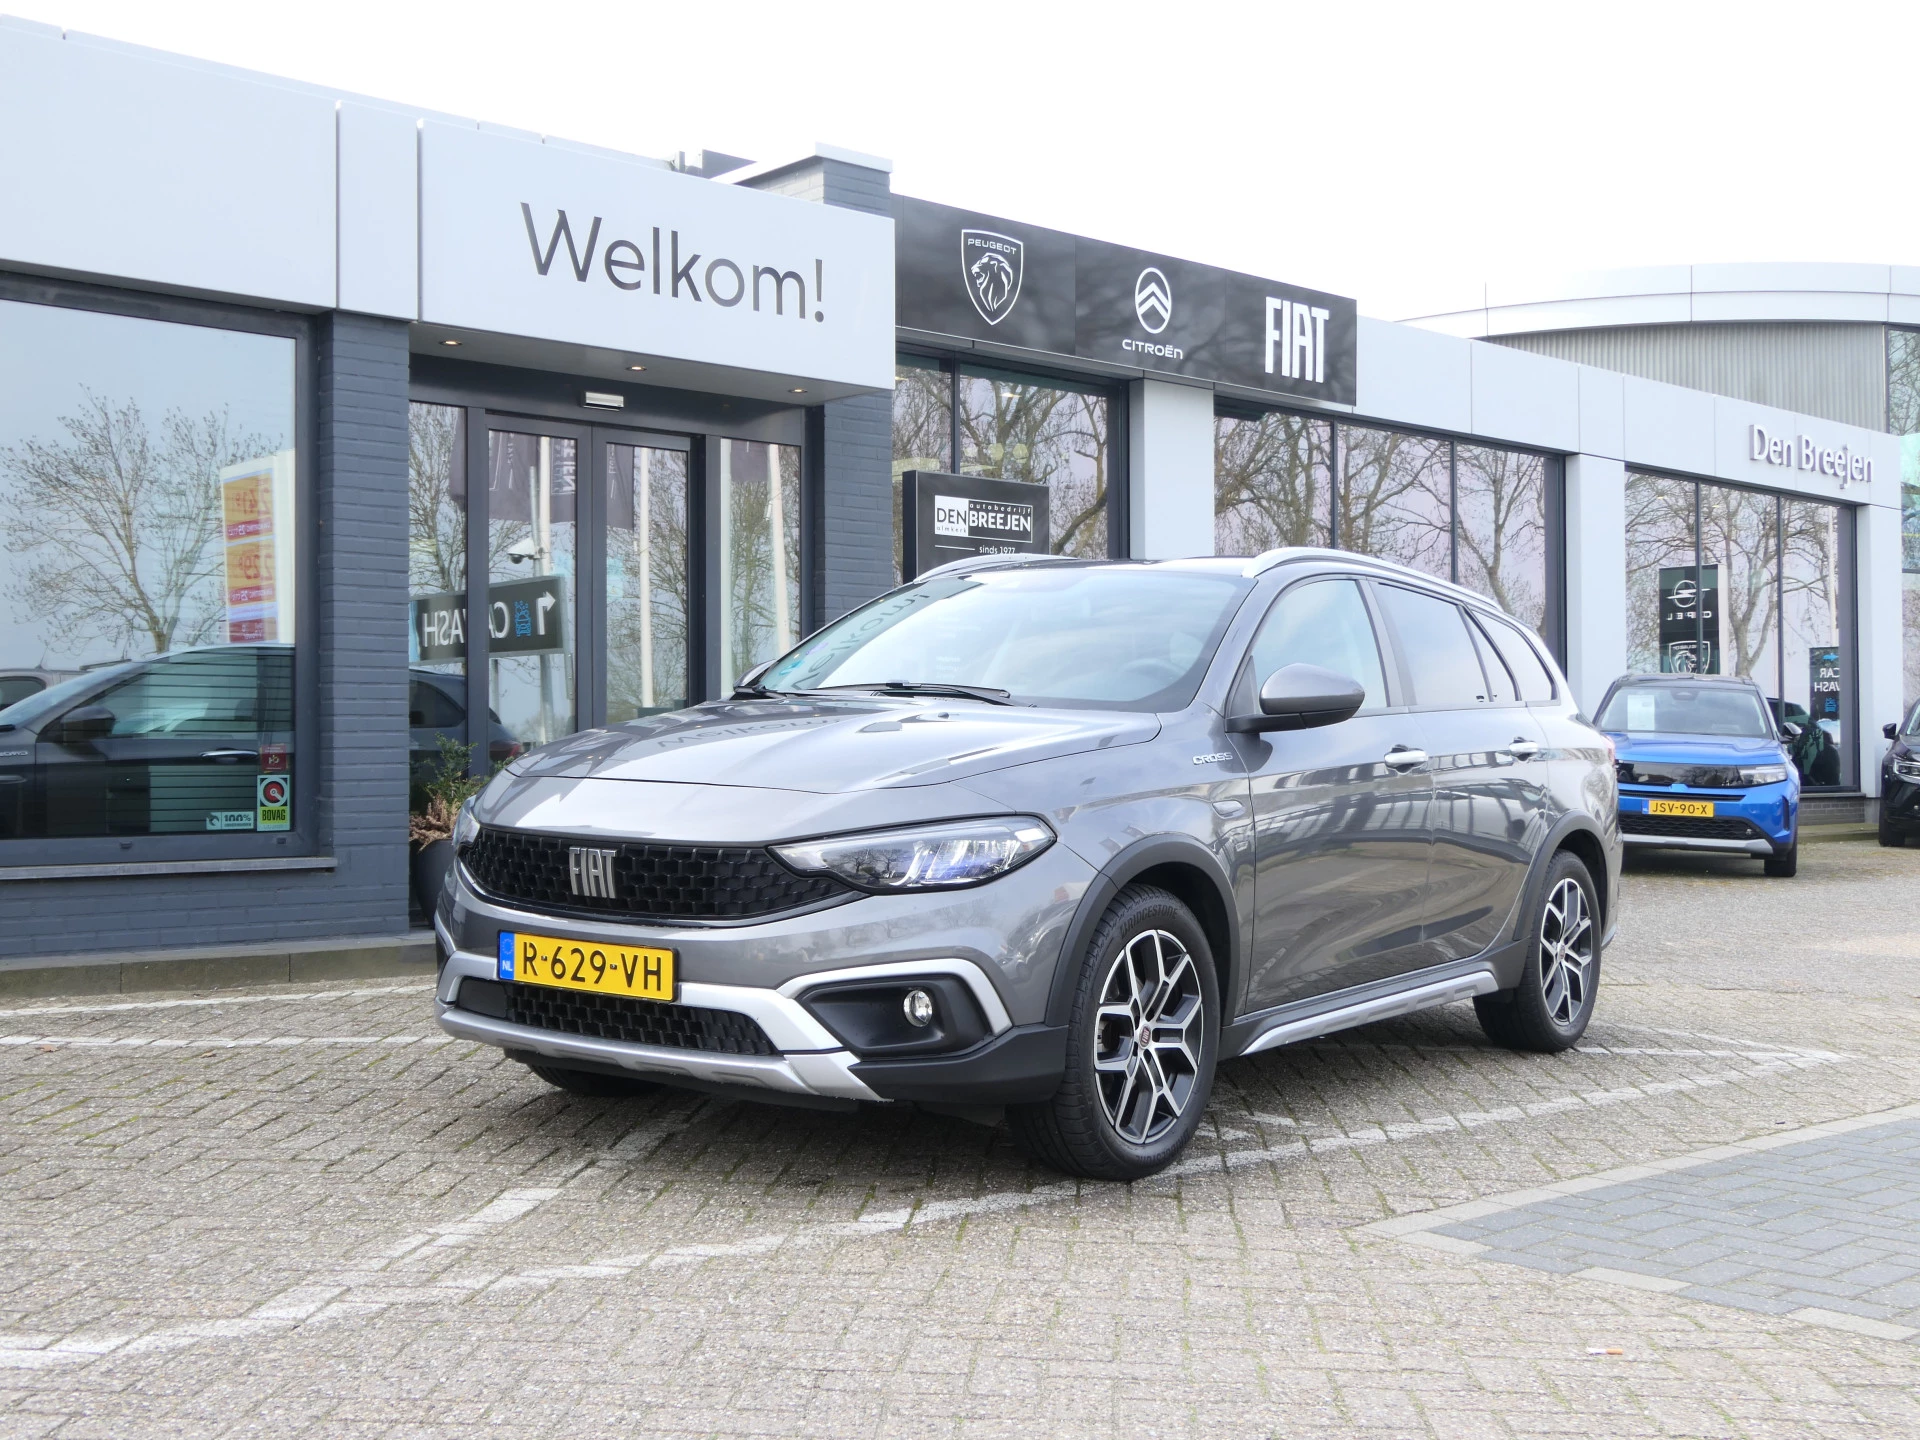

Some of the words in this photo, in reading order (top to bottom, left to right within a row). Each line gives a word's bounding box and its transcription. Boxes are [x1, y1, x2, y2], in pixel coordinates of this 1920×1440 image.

[967, 238, 1017, 255] PEUGEOT
[520, 202, 825, 323] Welkom!
[1265, 296, 1330, 384] FIAT
[1749, 424, 1793, 467] Den
[1797, 434, 1875, 489] Breejen
[969, 502, 1031, 514] autobedrijf
[936, 507, 967, 526] DEN
[969, 510, 1031, 533] BREEJEN
[979, 545, 998, 555] sinds
[1192, 752, 1233, 765] CROSS
[262, 809, 286, 821] BOVAG
[1652, 802, 1707, 815] JSV-90-X
[224, 814, 251, 822] 100%
[568, 846, 617, 899] FIAT
[502, 959, 513, 972] NL
[523, 941, 661, 992] R-629-VH
